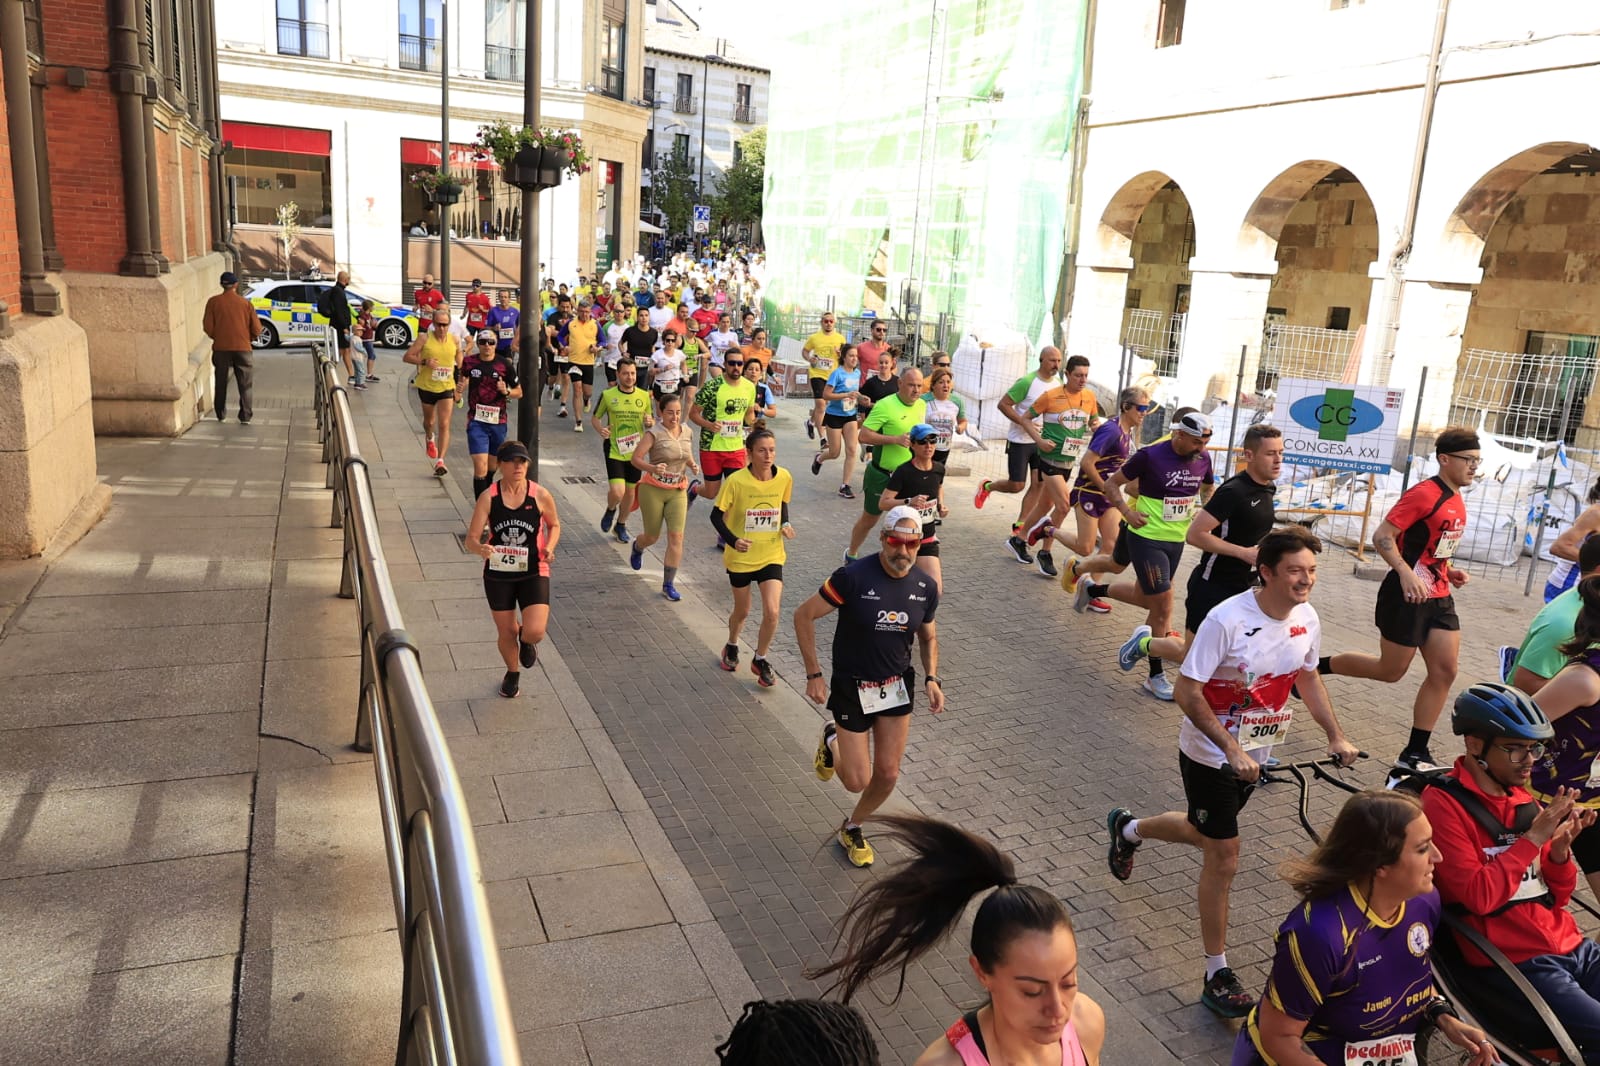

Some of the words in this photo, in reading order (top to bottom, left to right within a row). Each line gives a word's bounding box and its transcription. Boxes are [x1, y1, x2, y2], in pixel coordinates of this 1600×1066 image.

[1315, 404, 1357, 426] CG
[1283, 438, 1354, 457] CONGESA
[1358, 447, 1380, 459] XXI
[1172, 504, 1188, 514] 101
[754, 516, 771, 526] 171
[494, 547, 528, 556] edunia
[501, 555, 516, 565] 45
[877, 610, 909, 625] 200
[880, 687, 887, 699] 6
[1242, 713, 1291, 726] bedunia
[1250, 723, 1279, 738] 300
[1346, 1040, 1412, 1060] bedunia
